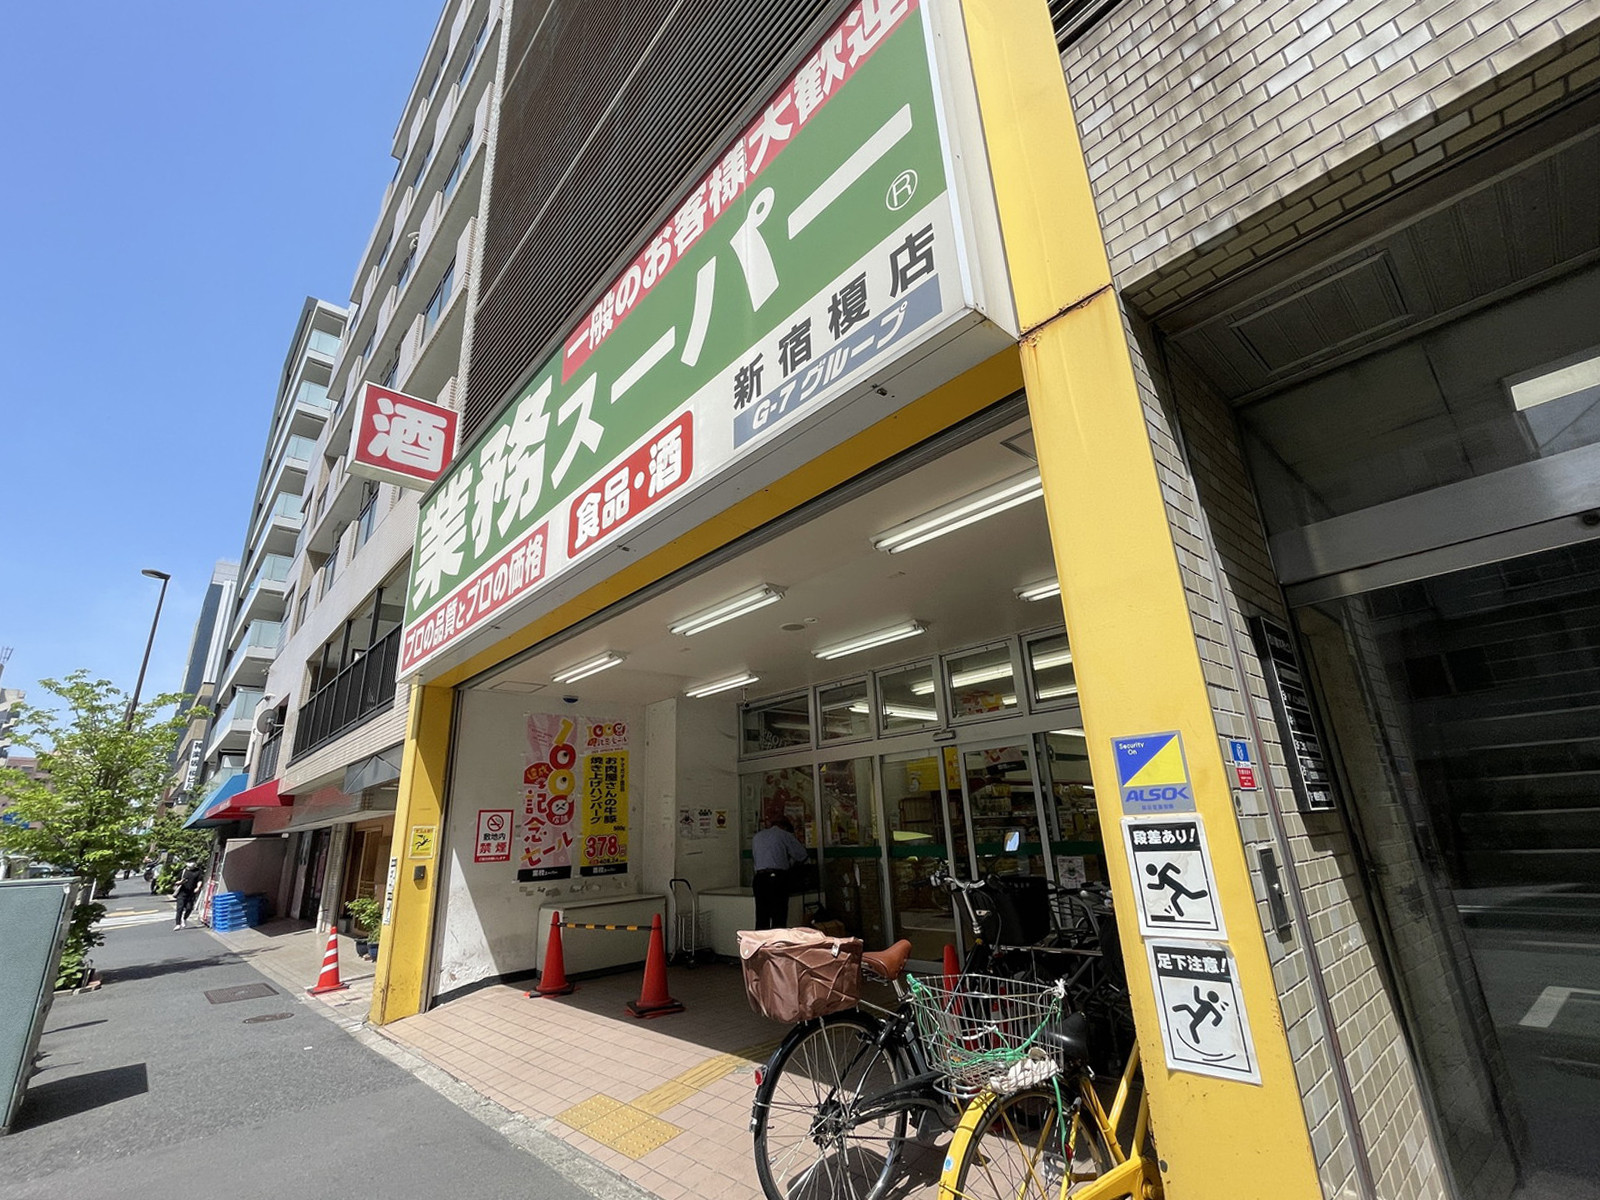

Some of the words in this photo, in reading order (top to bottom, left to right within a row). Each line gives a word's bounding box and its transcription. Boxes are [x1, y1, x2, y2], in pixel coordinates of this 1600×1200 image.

[567, 0, 909, 359] 一般のお客様大歓迎
[412, 103, 913, 611] 業務スーパー
[734, 222, 935, 410] 新宿榎店
[367, 397, 447, 473] 酒
[404, 534, 544, 665] プロの品質とプロの価格
[1119, 741, 1145, 750] Security
[1125, 786, 1190, 802] ALSOK
